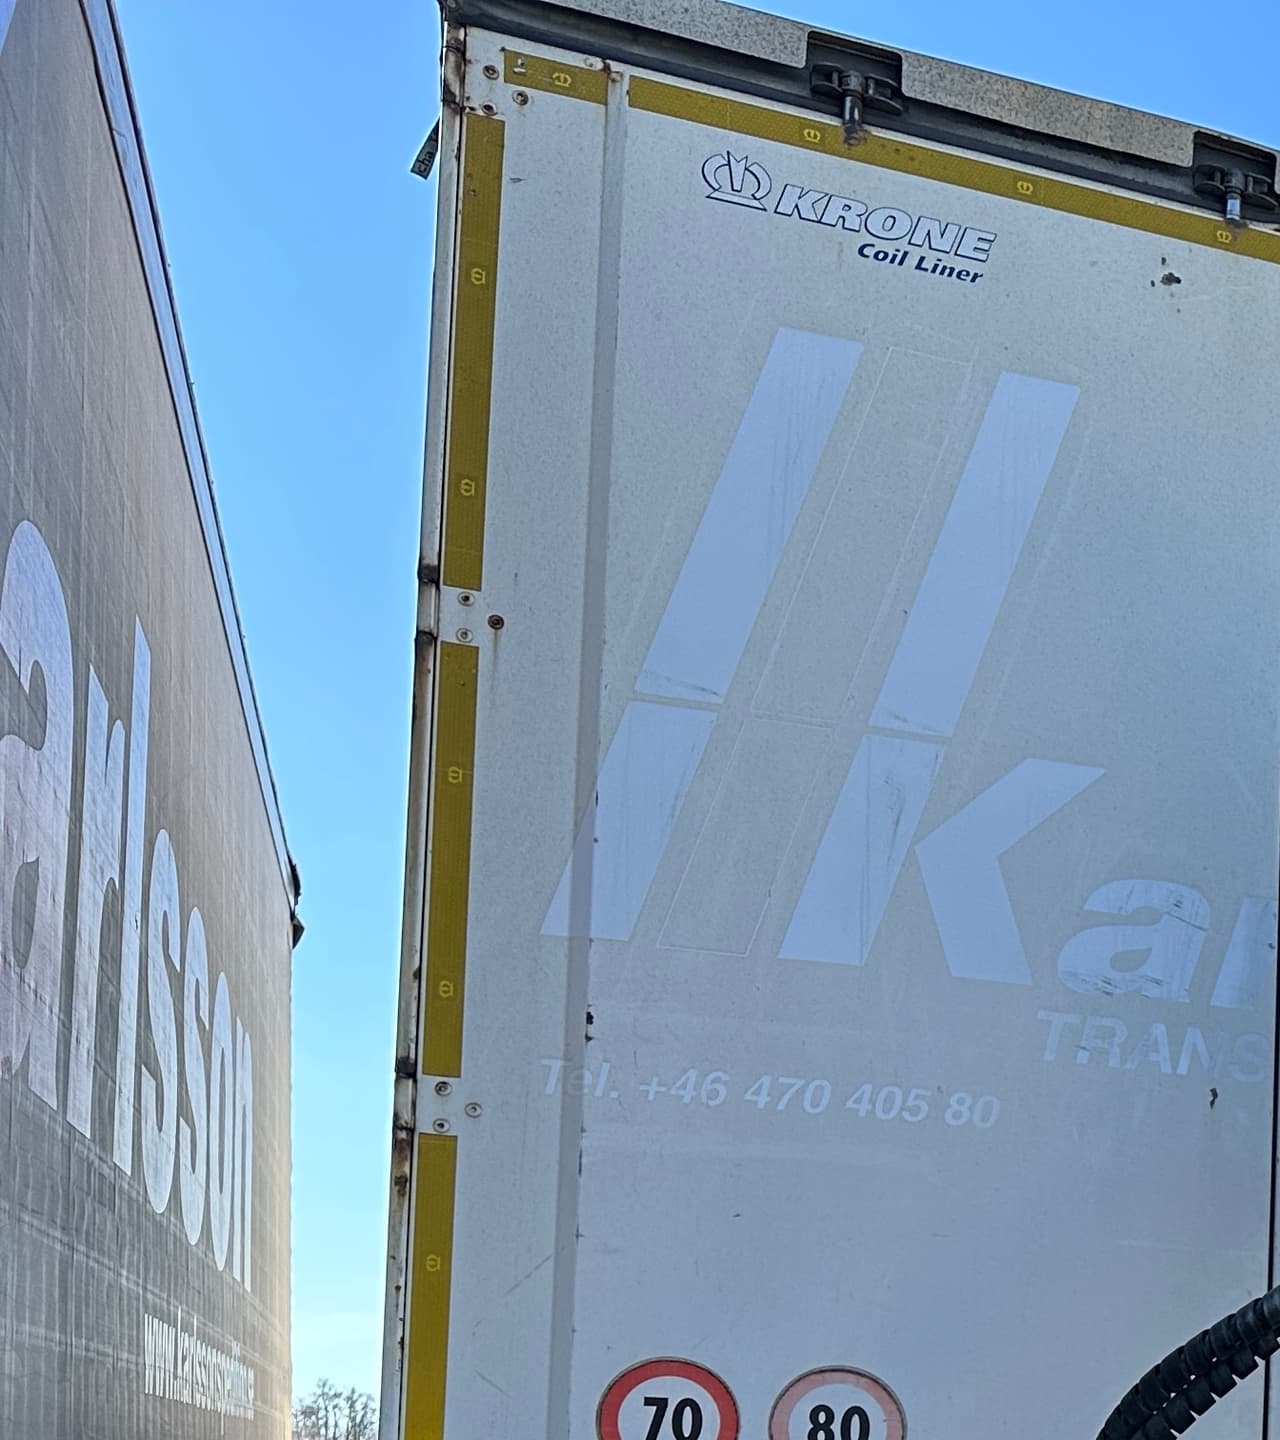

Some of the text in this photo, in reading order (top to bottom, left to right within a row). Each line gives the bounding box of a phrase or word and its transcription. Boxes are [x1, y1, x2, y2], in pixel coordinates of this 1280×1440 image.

[774, 184, 997, 263] KRONE
[857, 242, 984, 285] Coil Liner
[0, 520, 253, 1293] arlsson
[539, 1058, 999, 1129] Tel. +46 470 405 80
